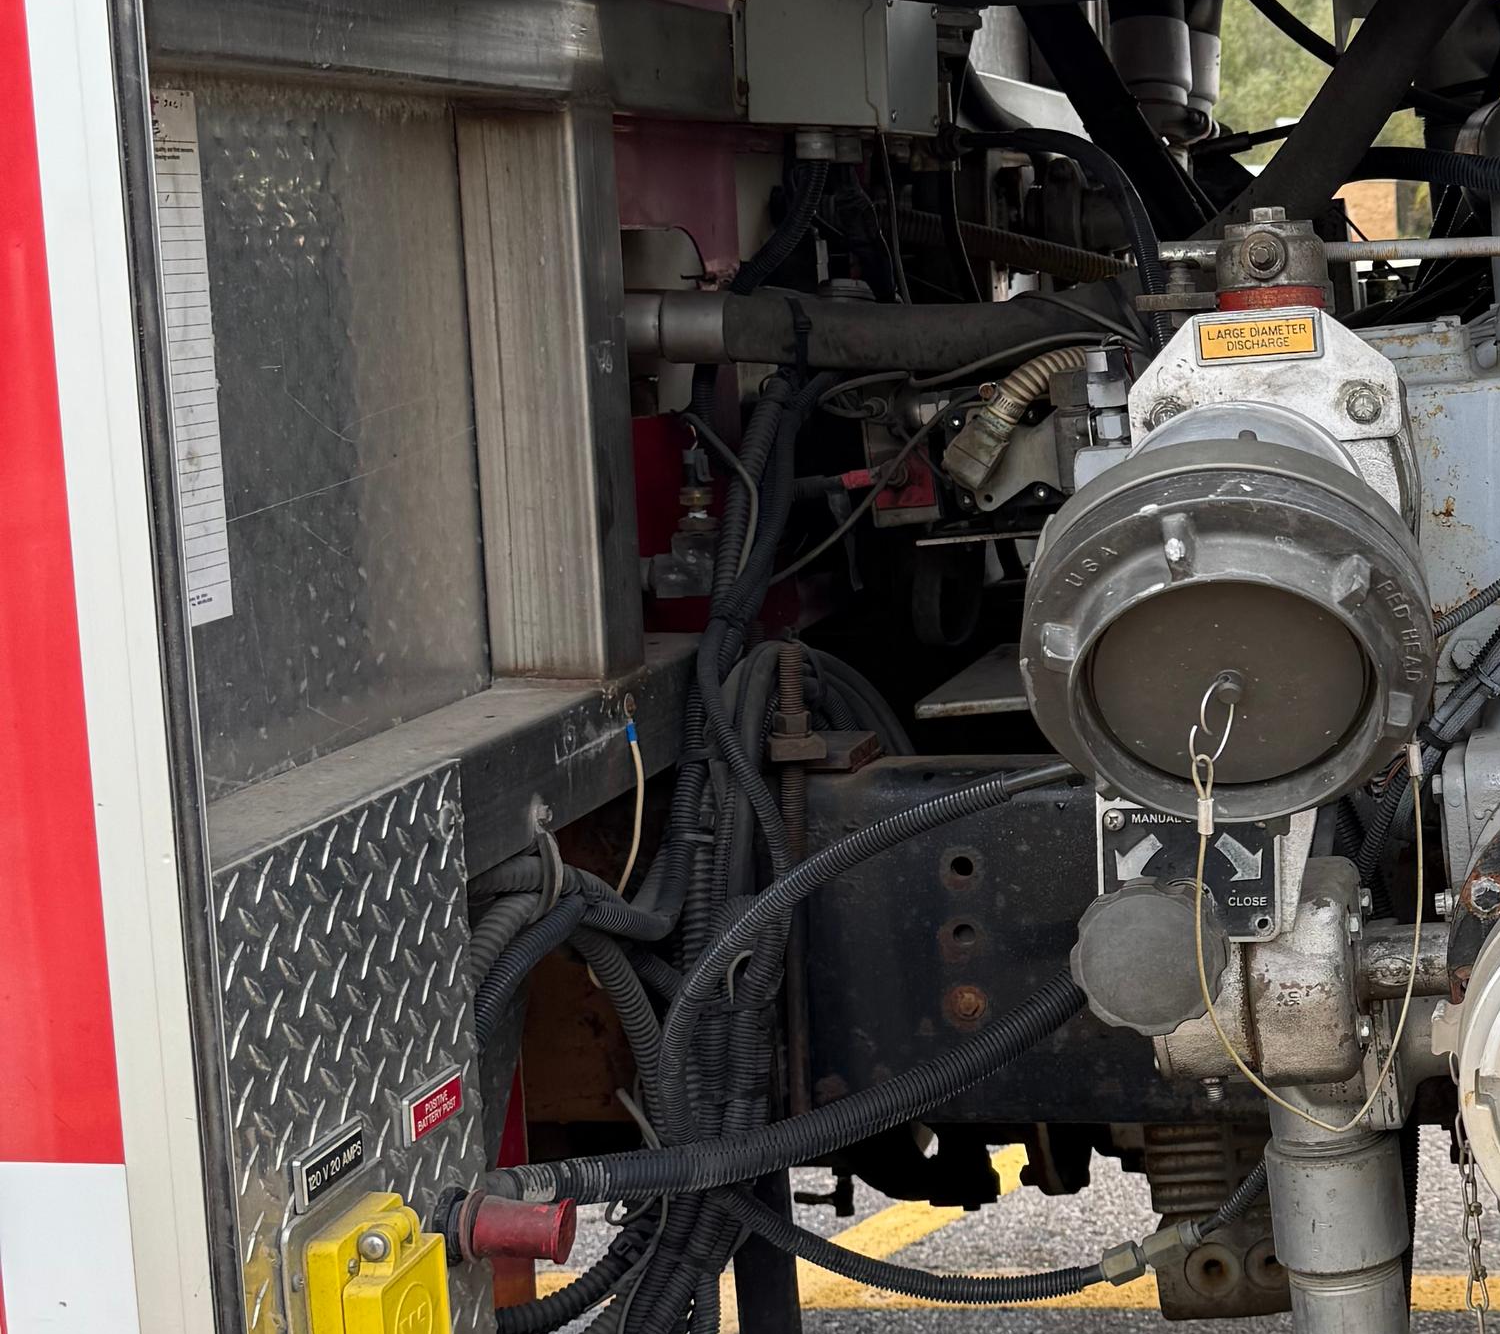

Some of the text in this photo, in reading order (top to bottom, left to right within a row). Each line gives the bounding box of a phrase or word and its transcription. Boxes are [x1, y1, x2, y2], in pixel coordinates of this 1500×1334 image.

[1207, 323, 1307, 340] LARGE DIAMETER
[1227, 337, 1290, 352] DISCHARGE
[1401, 628, 1423, 683] HEAD
[1228, 896, 1267, 907] CLOSE
[417, 1095, 456, 1132] BATTERY POST
[424, 1089, 448, 1114] POSITIVE
[342, 1140, 362, 1165] AMPS
